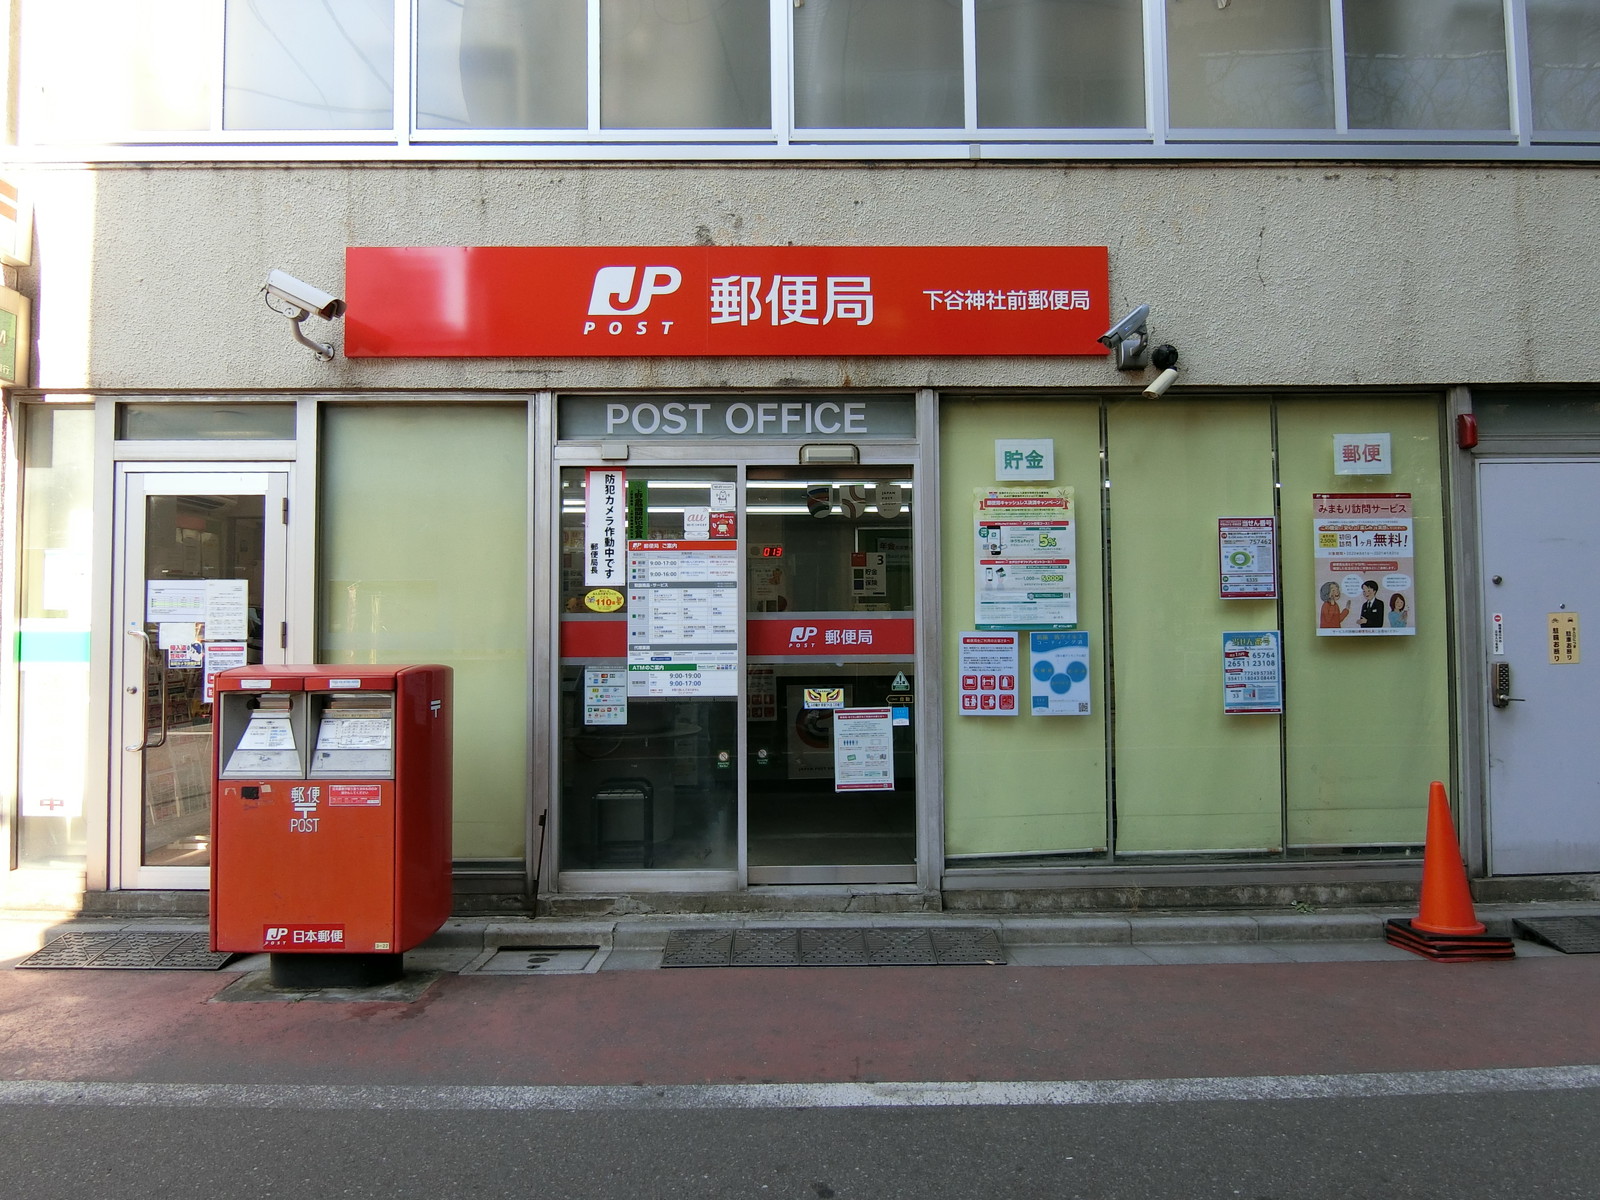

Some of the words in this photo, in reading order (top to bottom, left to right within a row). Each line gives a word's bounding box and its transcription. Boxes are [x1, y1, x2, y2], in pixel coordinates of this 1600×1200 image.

[587, 266, 682, 316] JP
[710, 275, 874, 327] 郵便局
[922, 289, 1091, 311] 下谷神社前郵便局
[583, 321, 675, 335] POST
[606, 403, 711, 434] POST
[725, 402, 868, 434] OFFICE
[1004, 449, 1044, 470] 貯金
[1342, 443, 1382, 463] 郵便
[1318, 504, 1407, 514] みまもり訪問サービス
[687, 514, 707, 522] au
[604, 474, 616, 579] 防犯カメラ作動中です
[590, 543, 599, 575] 郵便局長
[763, 547, 782, 557] 013
[877, 555, 884, 565] 3
[865, 568, 877, 576] 貯金
[790, 626, 818, 643] JP
[825, 629, 873, 645] 郵便局
[290, 786, 321, 803] 郵便
[290, 818, 321, 833] POST
[266, 928, 288, 941] JP
[293, 930, 343, 943] 日本郵便
